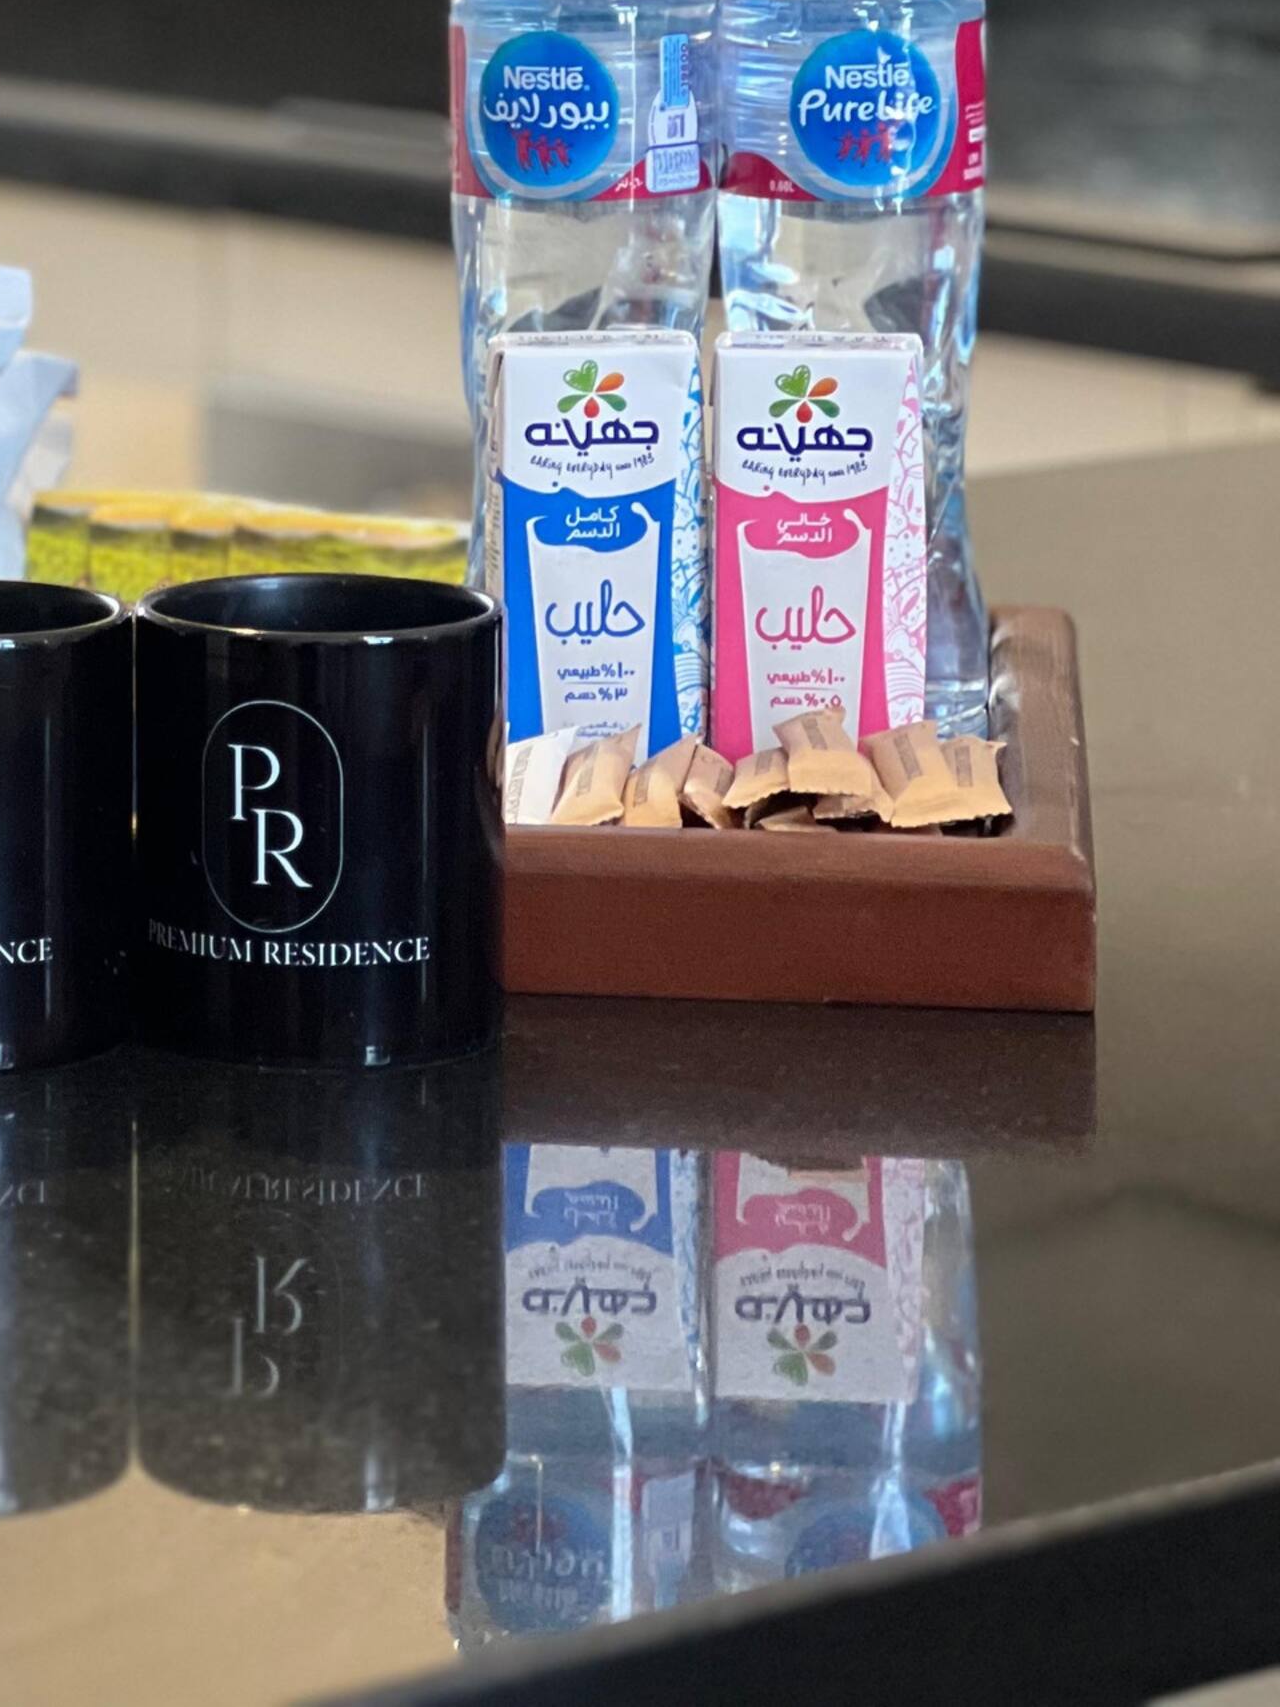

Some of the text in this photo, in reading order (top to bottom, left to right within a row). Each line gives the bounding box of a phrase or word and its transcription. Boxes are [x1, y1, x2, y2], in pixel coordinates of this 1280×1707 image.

[565, 505, 620, 527] كامل
[565, 522, 620, 542] الدسم
[776, 512, 832, 534] خالي
[776, 527, 833, 545] الدسم
[545, 579, 646, 645] حليب
[754, 585, 857, 651] حليب
[227, 743, 281, 821] P
[252, 808, 313, 889] R
[148, 918, 431, 967] PREMIUM RESIDENCE
